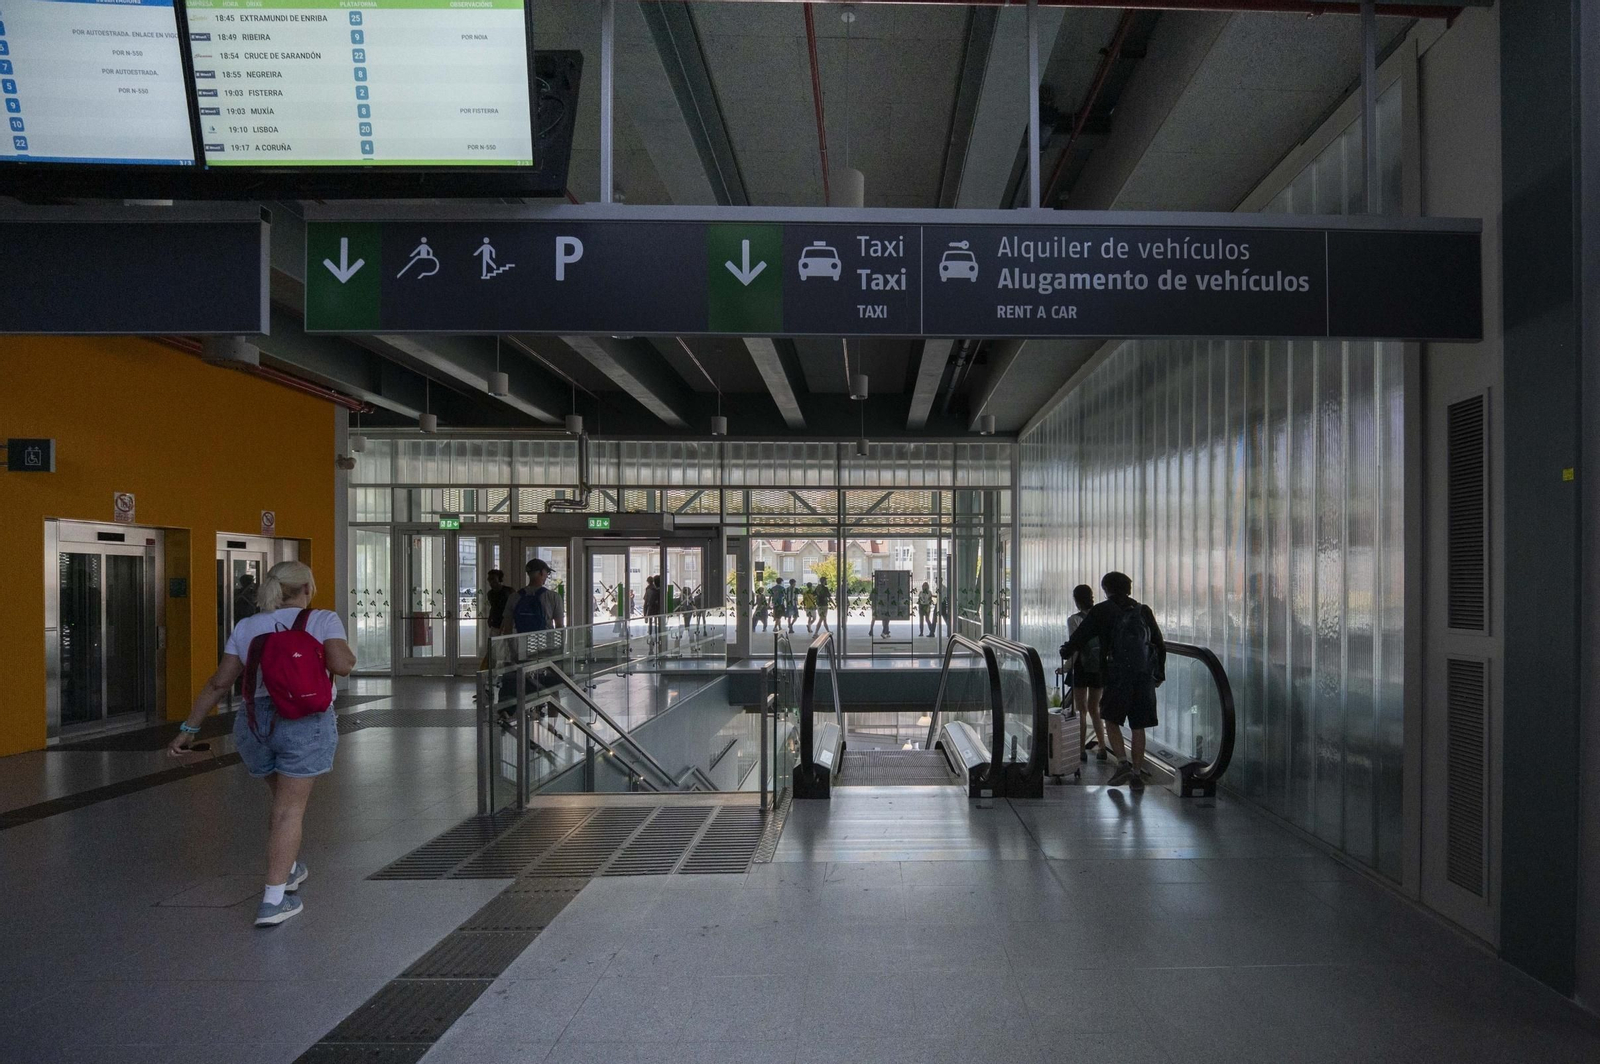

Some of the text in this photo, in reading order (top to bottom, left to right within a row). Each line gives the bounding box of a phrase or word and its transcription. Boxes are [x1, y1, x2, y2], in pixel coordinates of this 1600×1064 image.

[251, 107, 274, 115] MUXÍA
[857, 236, 904, 258] Taxi
[997, 236, 1250, 262] Alquiler de vehículos
[555, 236, 584, 281] P
[857, 268, 906, 291] Taxi
[997, 267, 1310, 295] Alugamento de vehículos
[857, 304, 887, 319] TAXI
[997, 304, 1077, 319] RENT A CAR
